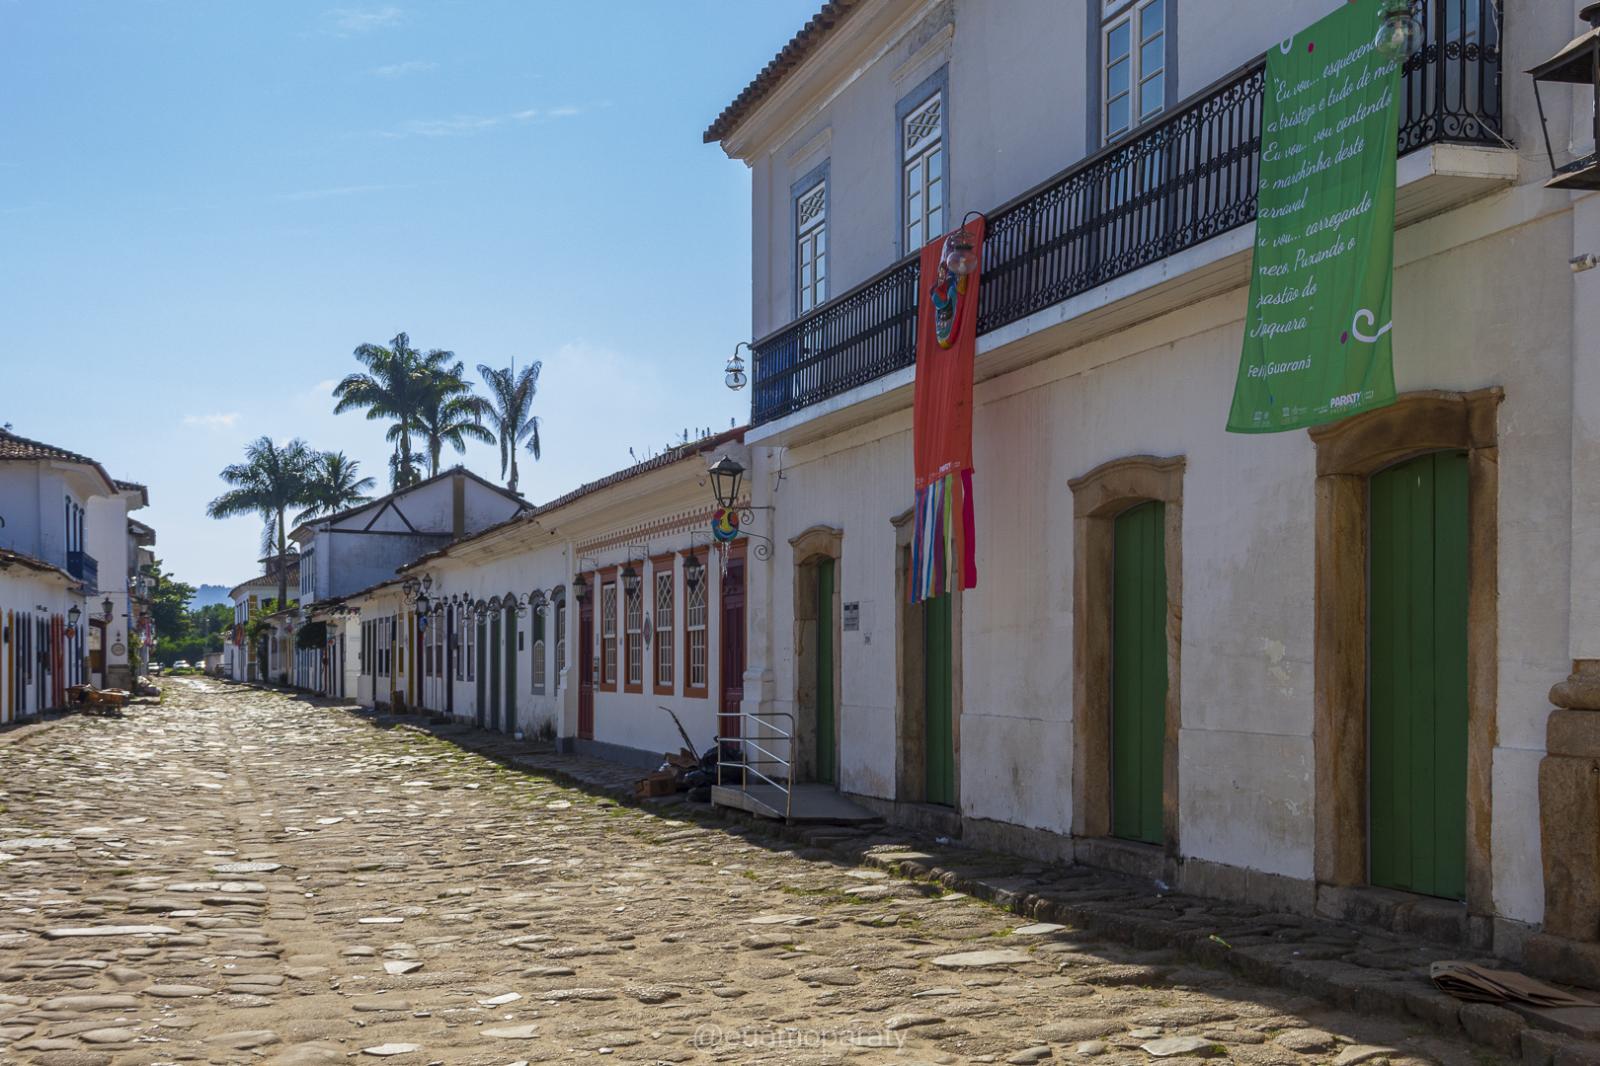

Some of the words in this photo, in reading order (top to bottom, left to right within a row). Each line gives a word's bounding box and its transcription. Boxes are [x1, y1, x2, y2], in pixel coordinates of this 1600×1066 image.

[1322, 33, 1382, 79] esquecend
[1327, 75, 1355, 107] tudo
[1356, 65, 1371, 91] de
[1262, 141, 1281, 162] Eu
[1313, 127, 1333, 144] vou
[1336, 85, 1393, 133] cantando
[1272, 150, 1332, 190] marchinha
[1334, 135, 1366, 164] deste
[1258, 186, 1309, 219] arnaval
[1305, 189, 1371, 237] carregando
[1293, 234, 1346, 272] Puxando
[1347, 237, 1356, 251] o
[1301, 274, 1318, 298] do
[1330, 391, 1362, 409] PARATY
